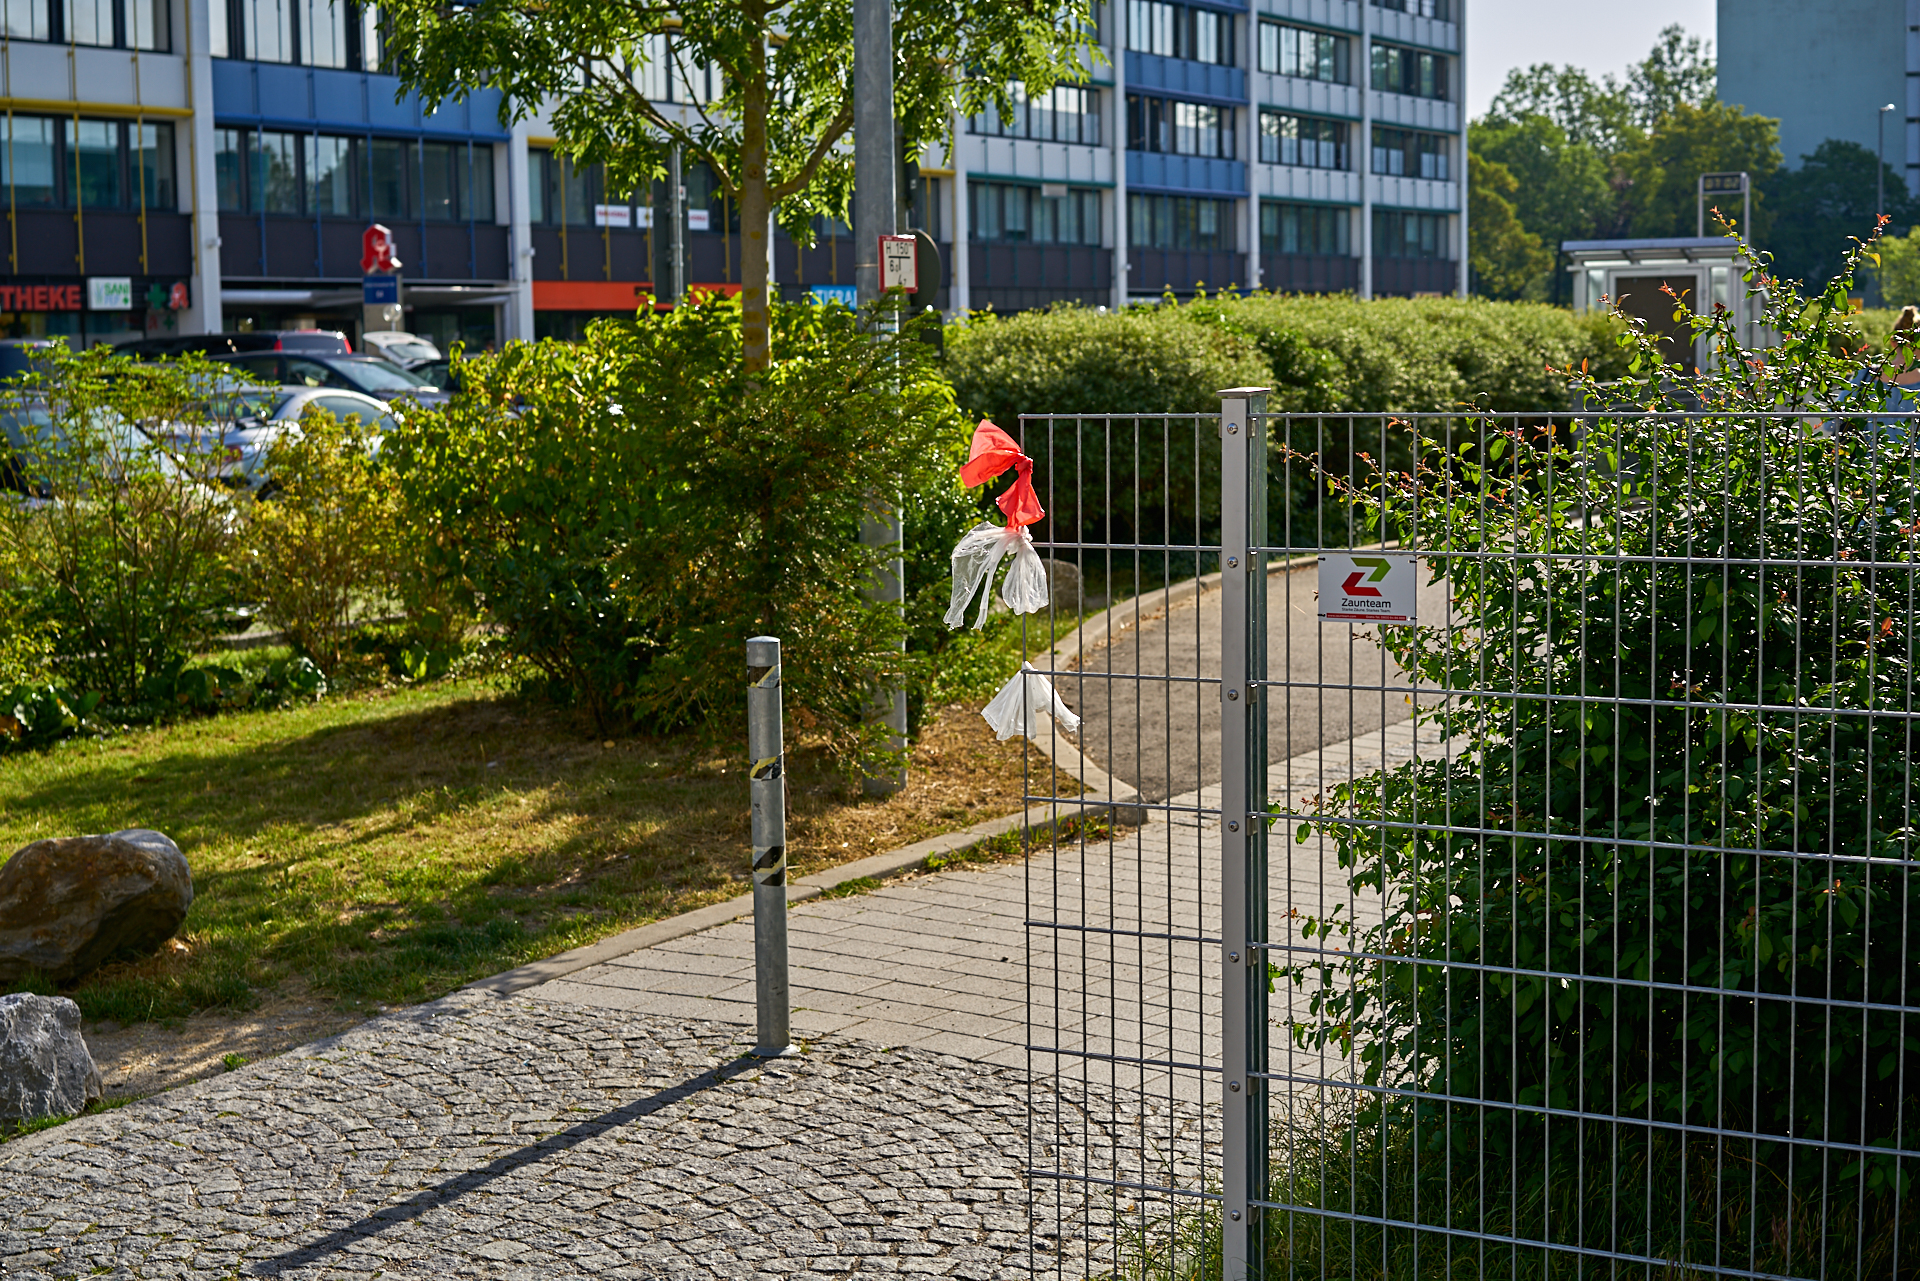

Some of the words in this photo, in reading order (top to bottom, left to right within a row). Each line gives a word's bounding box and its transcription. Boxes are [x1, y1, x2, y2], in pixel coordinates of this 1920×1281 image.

[104, 282, 129, 295] SANI
[0, 285, 82, 311] THEKE
[1341, 598, 1391, 608] Zaunteam
